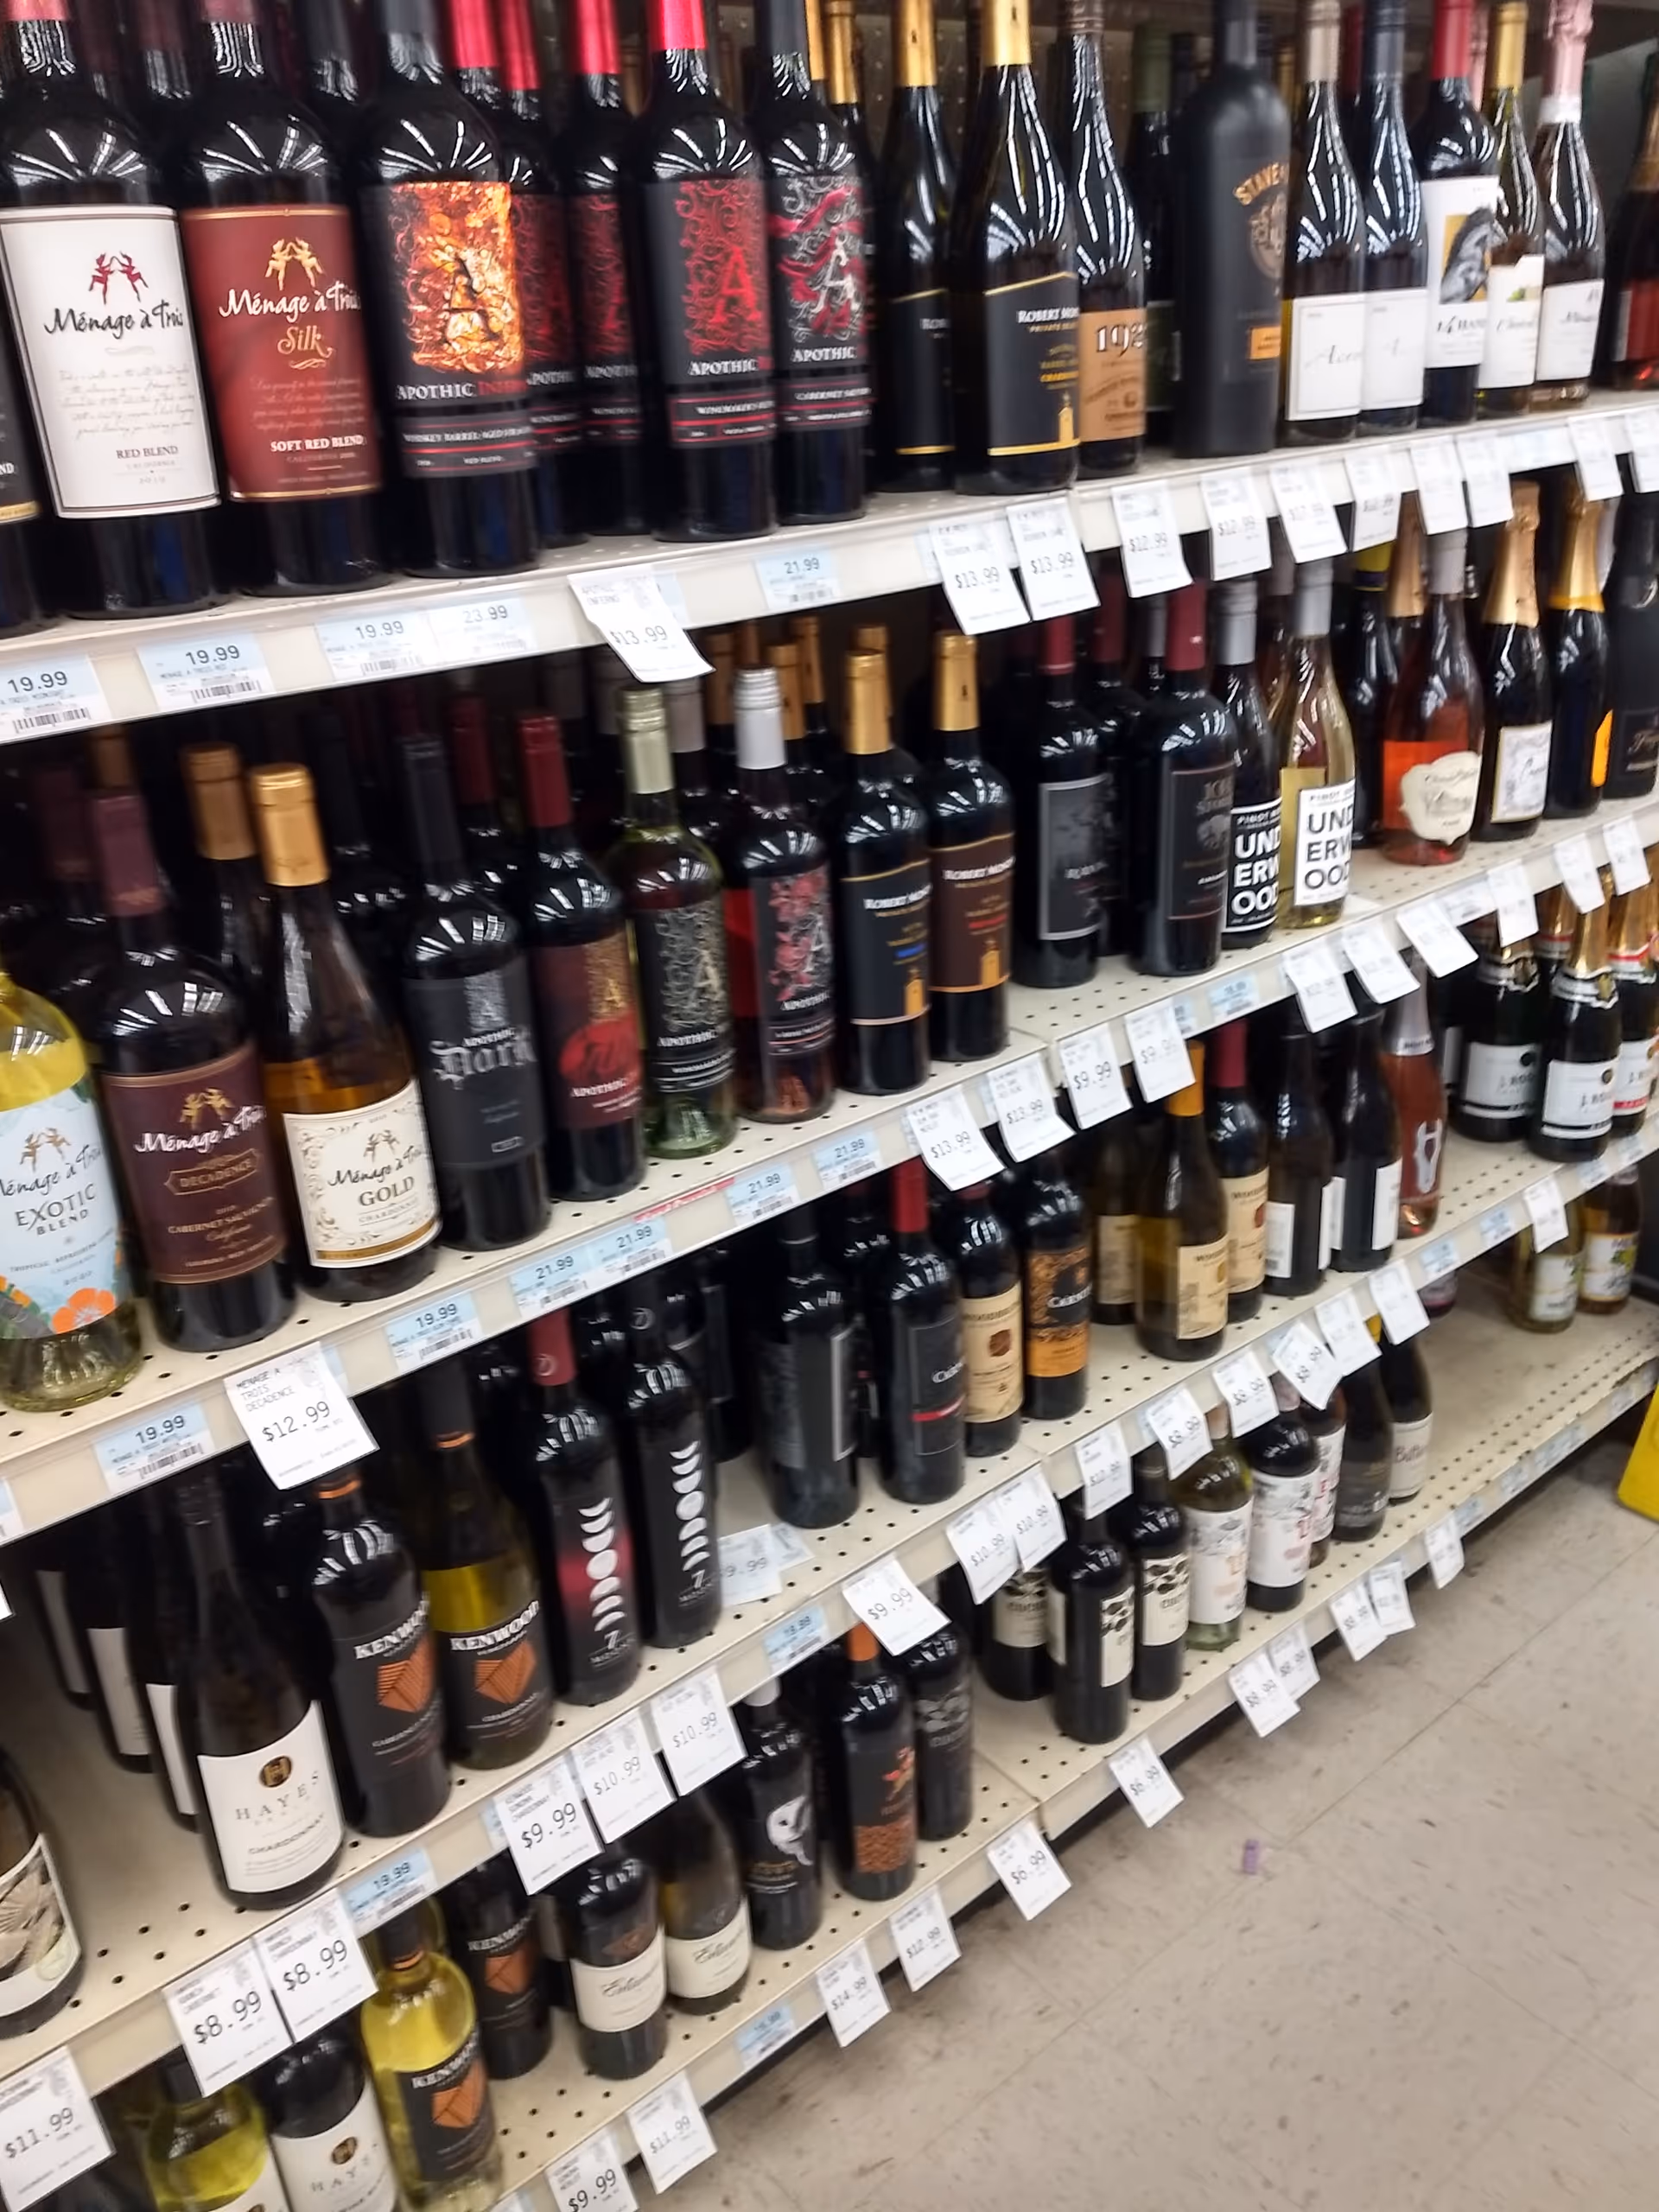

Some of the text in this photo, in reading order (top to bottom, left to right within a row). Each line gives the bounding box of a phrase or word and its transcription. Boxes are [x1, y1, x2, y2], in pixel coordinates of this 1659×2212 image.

[219, 289, 309, 323] Ménage
[315, 290, 327, 312] à
[1016, 308, 1060, 323] ROBERT
[44, 308, 135, 340] Ménage
[139, 308, 153, 328] à
[277, 325, 334, 359] Silk
[791, 346, 859, 363] APOTHIC
[689, 359, 758, 376] APOTHIC
[397, 384, 476, 401] APOTHIC
[116, 444, 179, 461] RED BLEND
[270, 441, 302, 453] SOFT
[305, 438, 329, 451] RED
[784, 557, 820, 575] 21.99
[463, 606, 508, 625] 23.99
[355, 621, 404, 640] 19.99
[609, 625, 668, 646] $13.99
[185, 644, 240, 666] 19.99
[7, 671, 67, 695] 19.99
[1072, 1060, 1112, 1090] $9.99
[134, 1131, 221, 1154] Ménage
[931, 1131, 971, 1159] $13.99
[180, 1158, 253, 1188] DECADENCE
[359, 1175, 416, 1207] GOLD
[15, 1182, 97, 1231] EXOTIC
[36, 1208, 90, 1236] BLEND
[616, 1225, 653, 1249] 21.99
[536, 1255, 575, 1280] 21.99
[415, 1303, 457, 1328] 19.99
[136, 1414, 186, 1445] 19.99
[262, 1400, 331, 1443] $12.99
[868, 1586, 914, 1622] $9.99
[672, 1711, 718, 1750] $10.99
[593, 1756, 641, 1797] $10.99
[520, 1802, 578, 1850] $9.99
[283, 1939, 348, 1992] $8.99
[193, 1990, 263, 2045] $8.99
[4, 2107, 74, 2159] $11.99
[568, 2168, 617, 2212] $9.99
